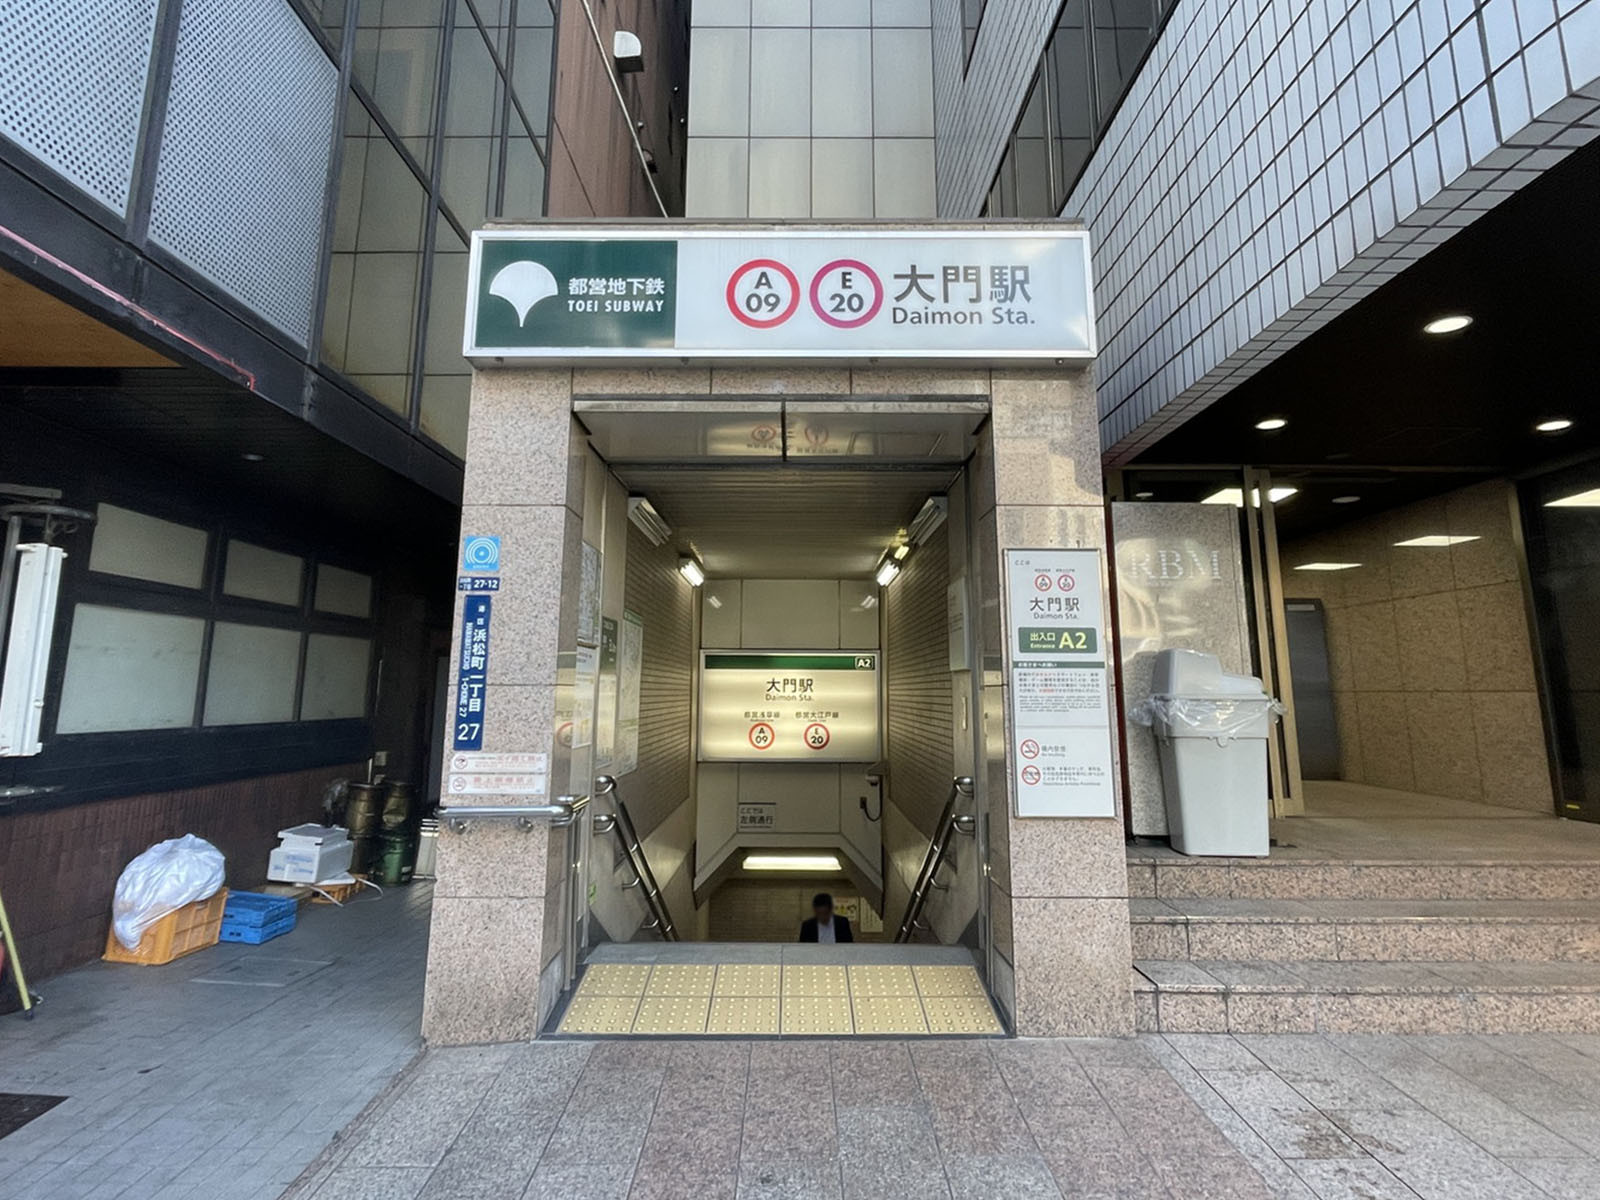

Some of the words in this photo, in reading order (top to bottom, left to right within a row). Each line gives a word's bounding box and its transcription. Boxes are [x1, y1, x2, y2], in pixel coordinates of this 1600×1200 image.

[568, 277, 665, 295] 都営地下鉄
[753, 271, 773, 289] A
[841, 271, 853, 289] E
[893, 264, 1032, 303] 大門駅
[567, 300, 599, 312] TOEI
[604, 300, 664, 312] SUBWAY
[745, 293, 781, 313] 09
[829, 293, 864, 313] 20
[892, 306, 983, 325] Daimon
[991, 306, 1036, 325] Sta.
[1127, 550, 1222, 580] RBM
[1029, 597, 1080, 612] 大門駅
[1033, 612, 1063, 620] Daimon
[1030, 632, 1056, 641] 出入口
[1058, 632, 1088, 649] A2
[858, 658, 871, 668] A2
[766, 678, 814, 693] 大門駅
[457, 723, 480, 741] 27
[755, 735, 769, 744] 09
[810, 735, 824, 745] 20
